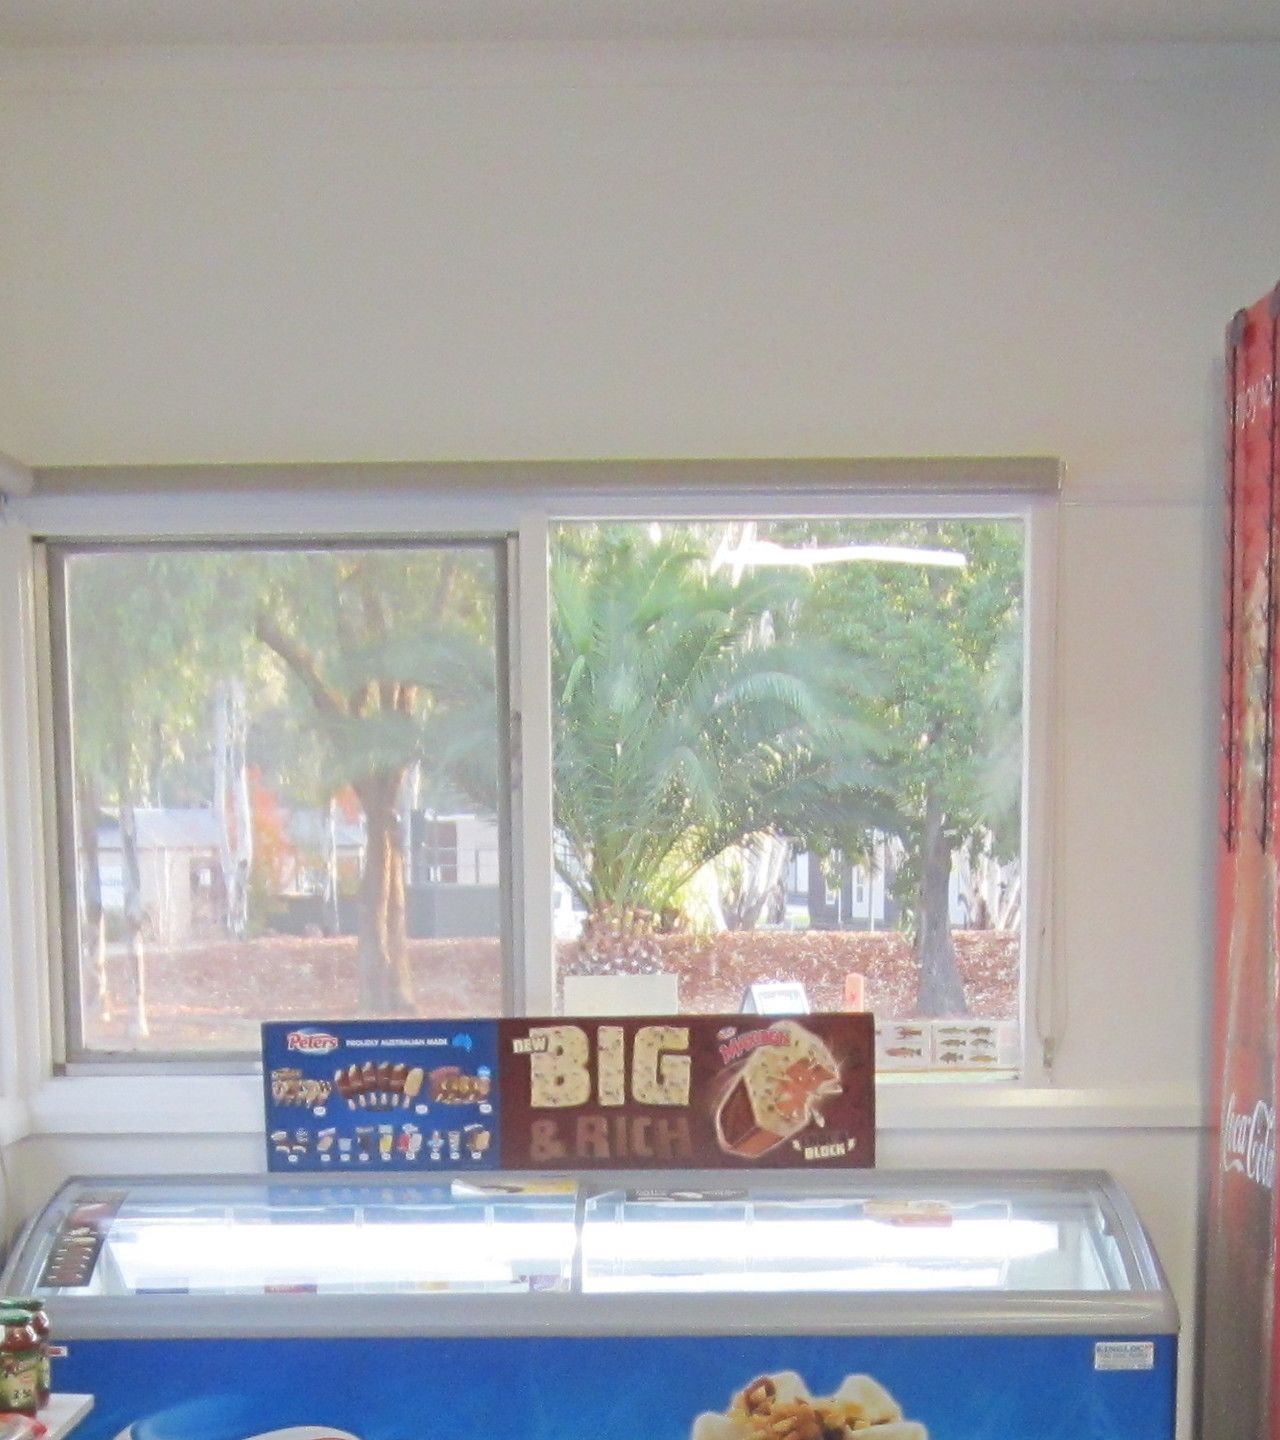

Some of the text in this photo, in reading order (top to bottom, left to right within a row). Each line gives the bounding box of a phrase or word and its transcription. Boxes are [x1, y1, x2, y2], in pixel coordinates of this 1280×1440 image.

[287, 1031, 339, 1051] Peters
[528, 1024, 692, 1109] BIG
[529, 1115, 691, 1162] & RICH
